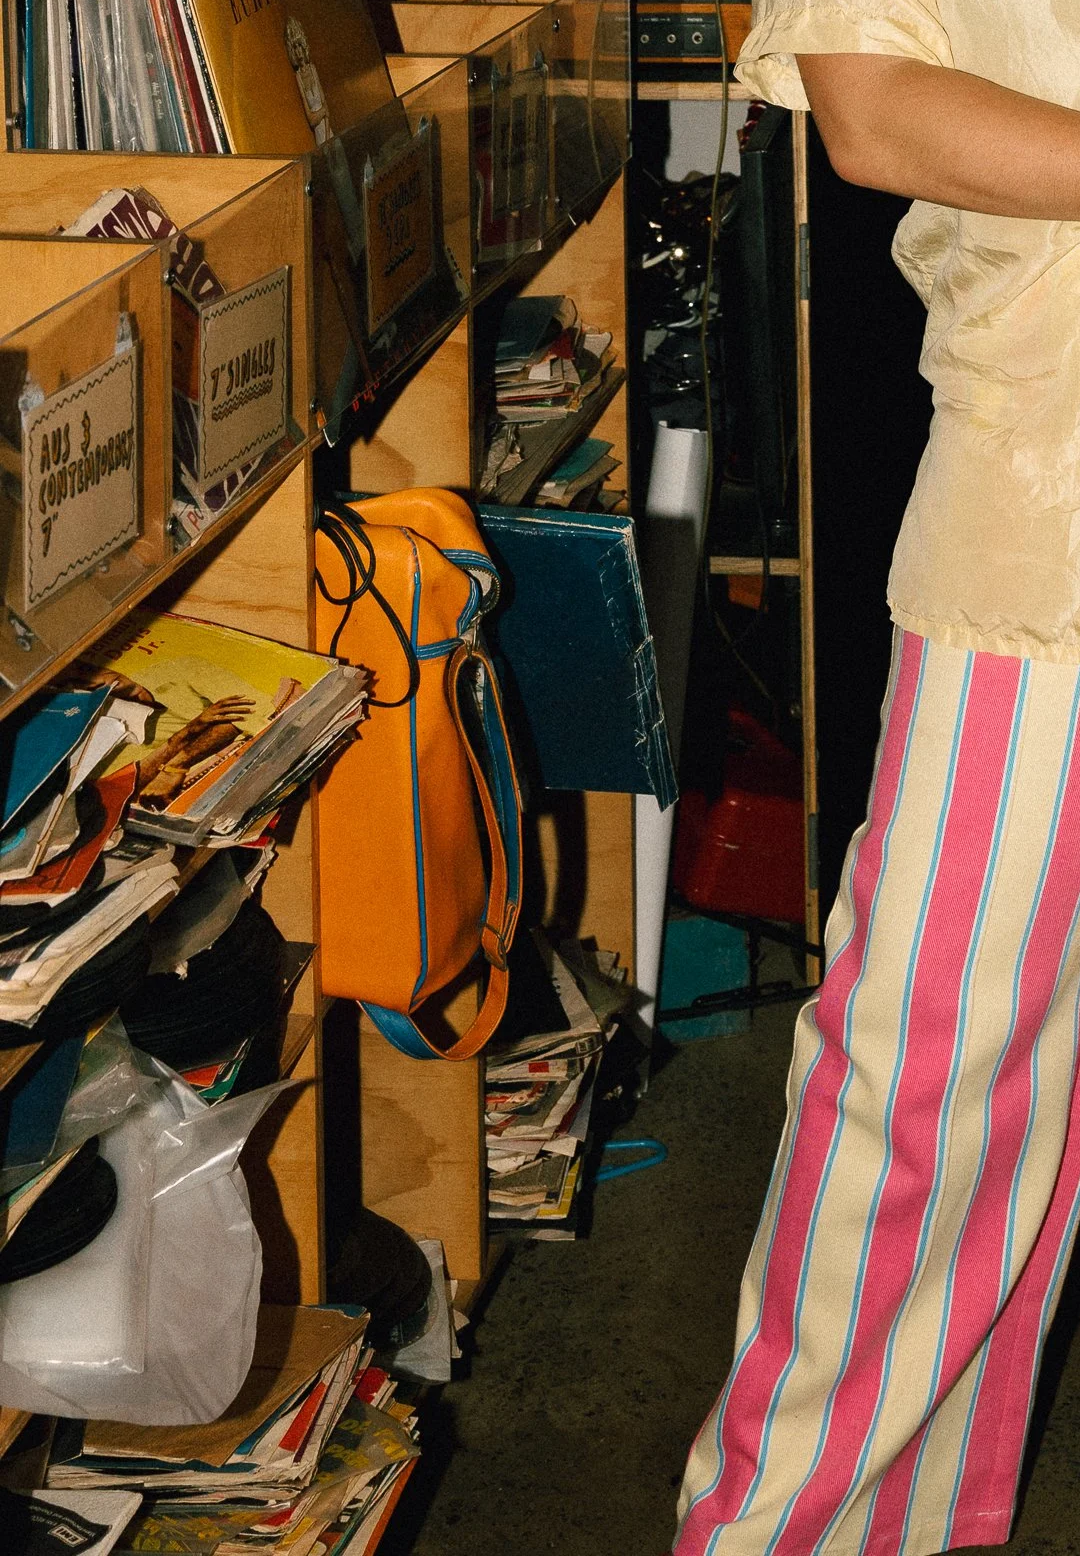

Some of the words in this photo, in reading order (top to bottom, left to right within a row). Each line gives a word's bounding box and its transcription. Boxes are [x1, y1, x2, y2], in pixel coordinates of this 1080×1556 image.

[226, 337, 276, 392] SINGLES
[39, 426, 134, 515] CONTEMPORARY
[40, 423, 70, 474] AUS
[41, 510, 58, 558] 7"
[104, 628, 150, 661] Davis
[138, 640, 165, 657] Jr.
[56, 1527, 78, 1543] EMI
